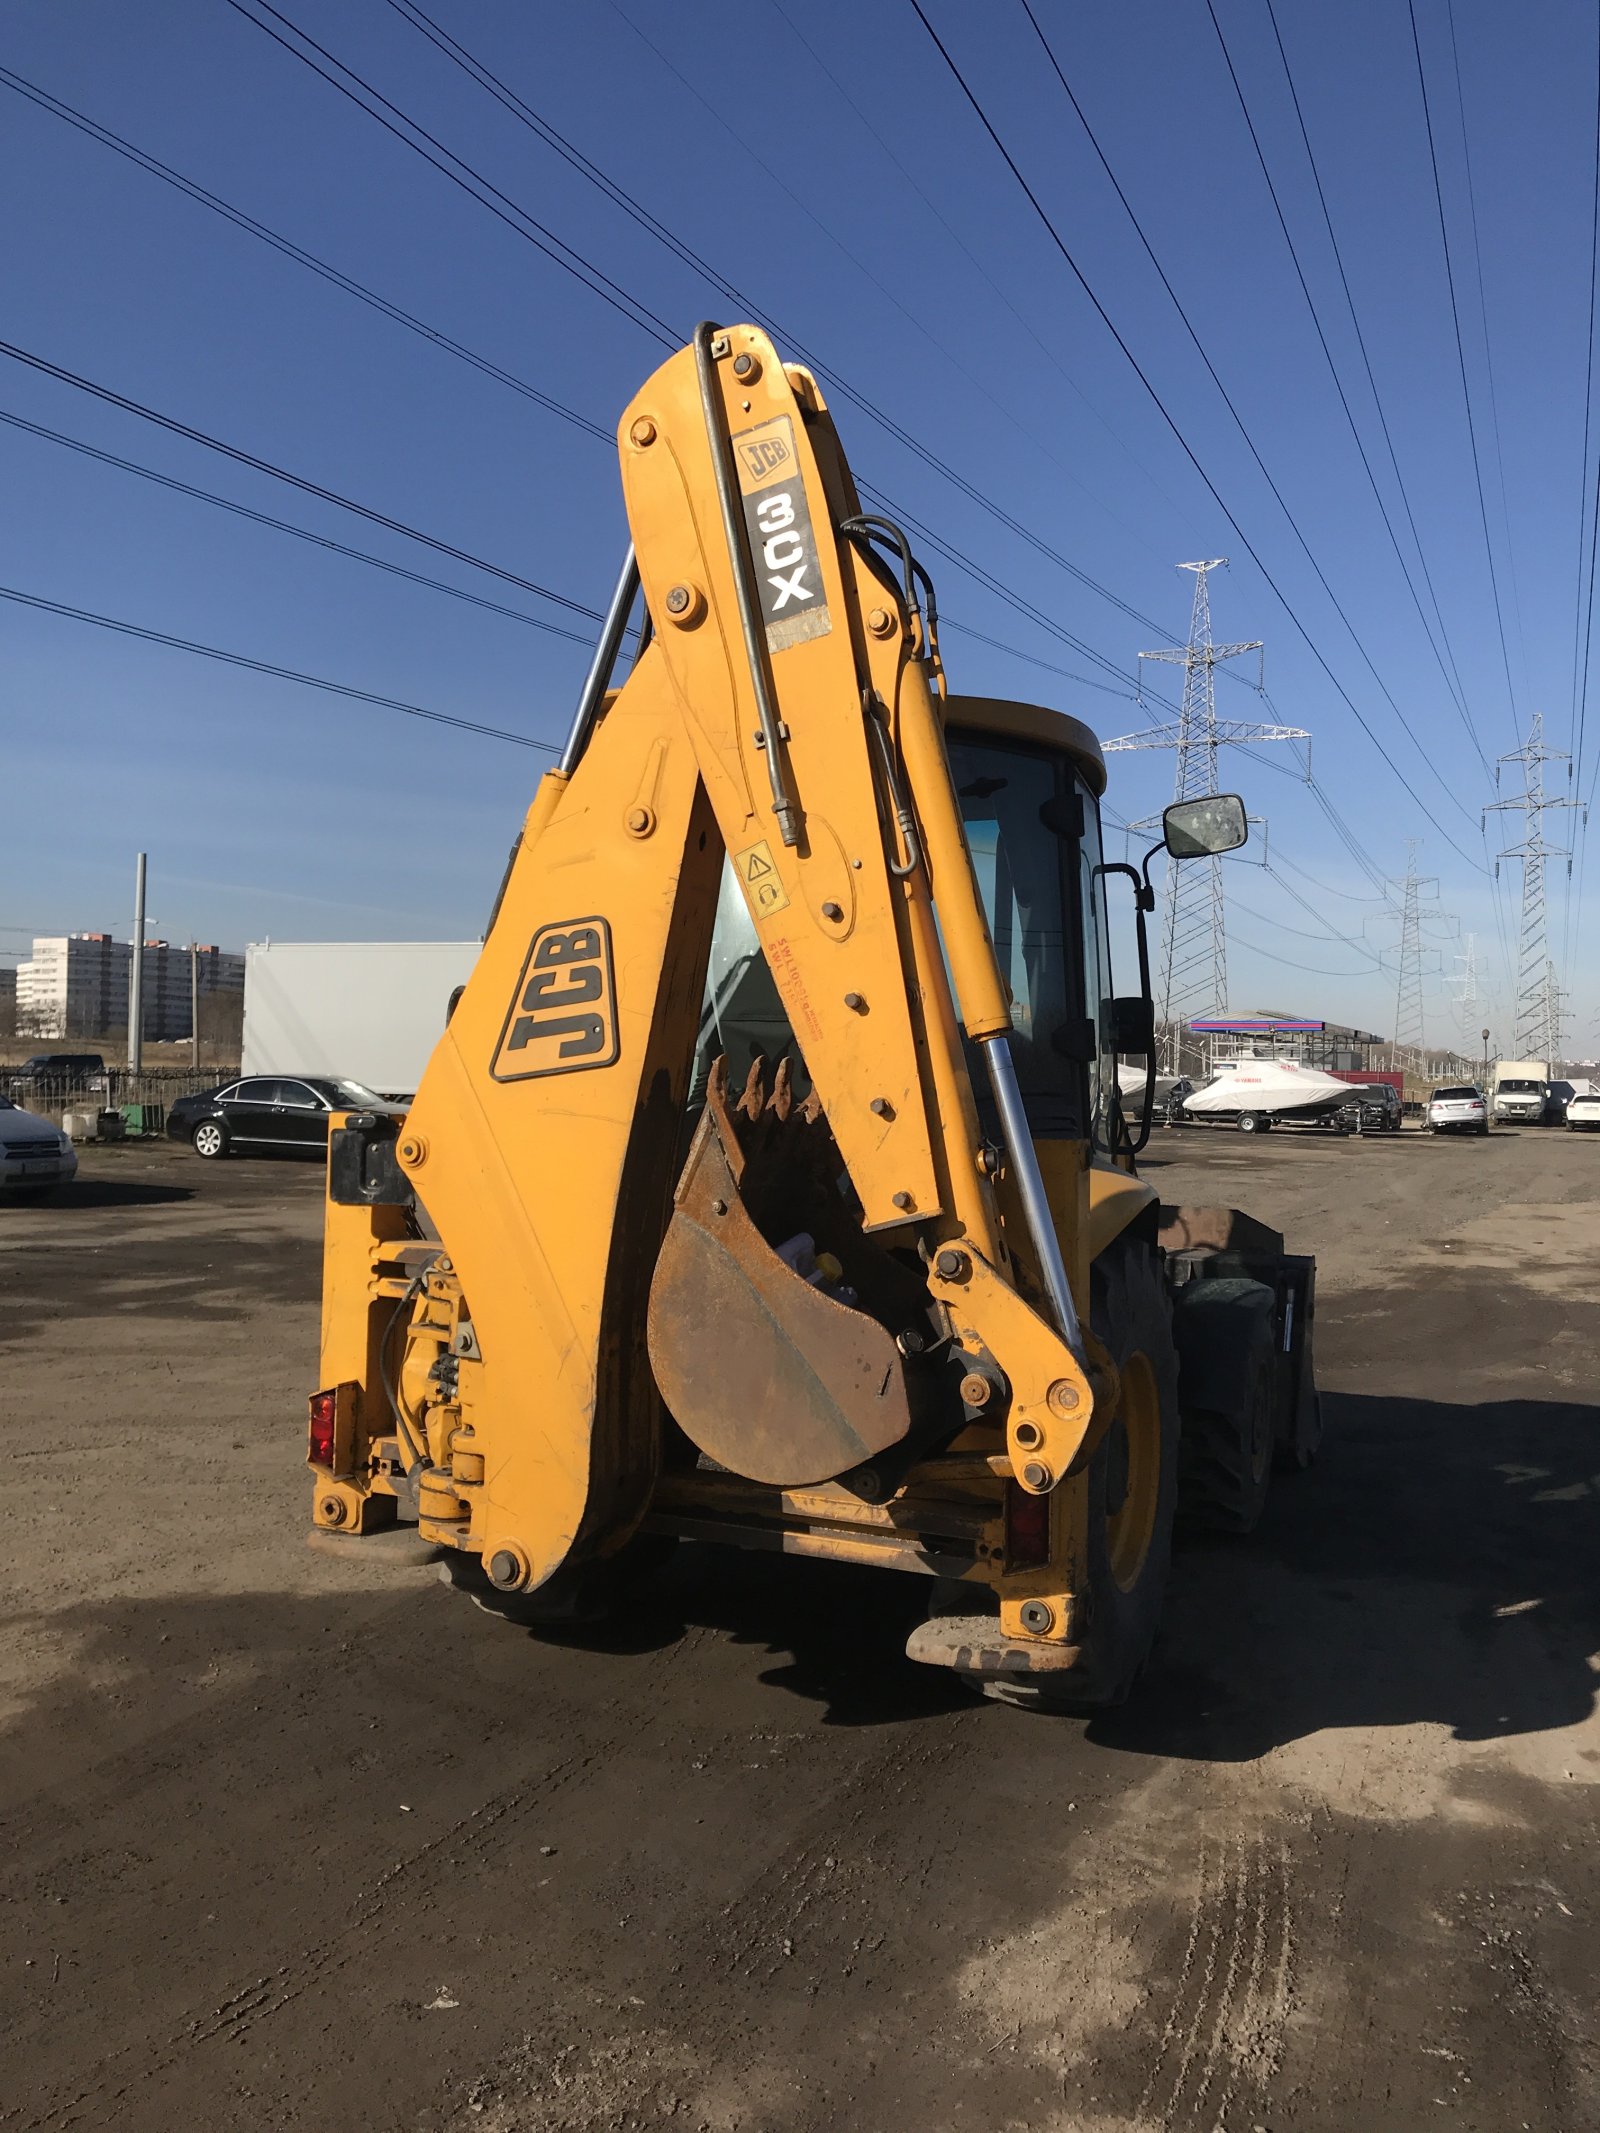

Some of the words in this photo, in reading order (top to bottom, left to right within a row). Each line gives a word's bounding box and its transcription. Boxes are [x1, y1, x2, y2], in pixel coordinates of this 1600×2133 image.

[747, 441, 787, 476] JCB
[756, 492, 815, 612] 3CX
[507, 927, 605, 1059] JCB
